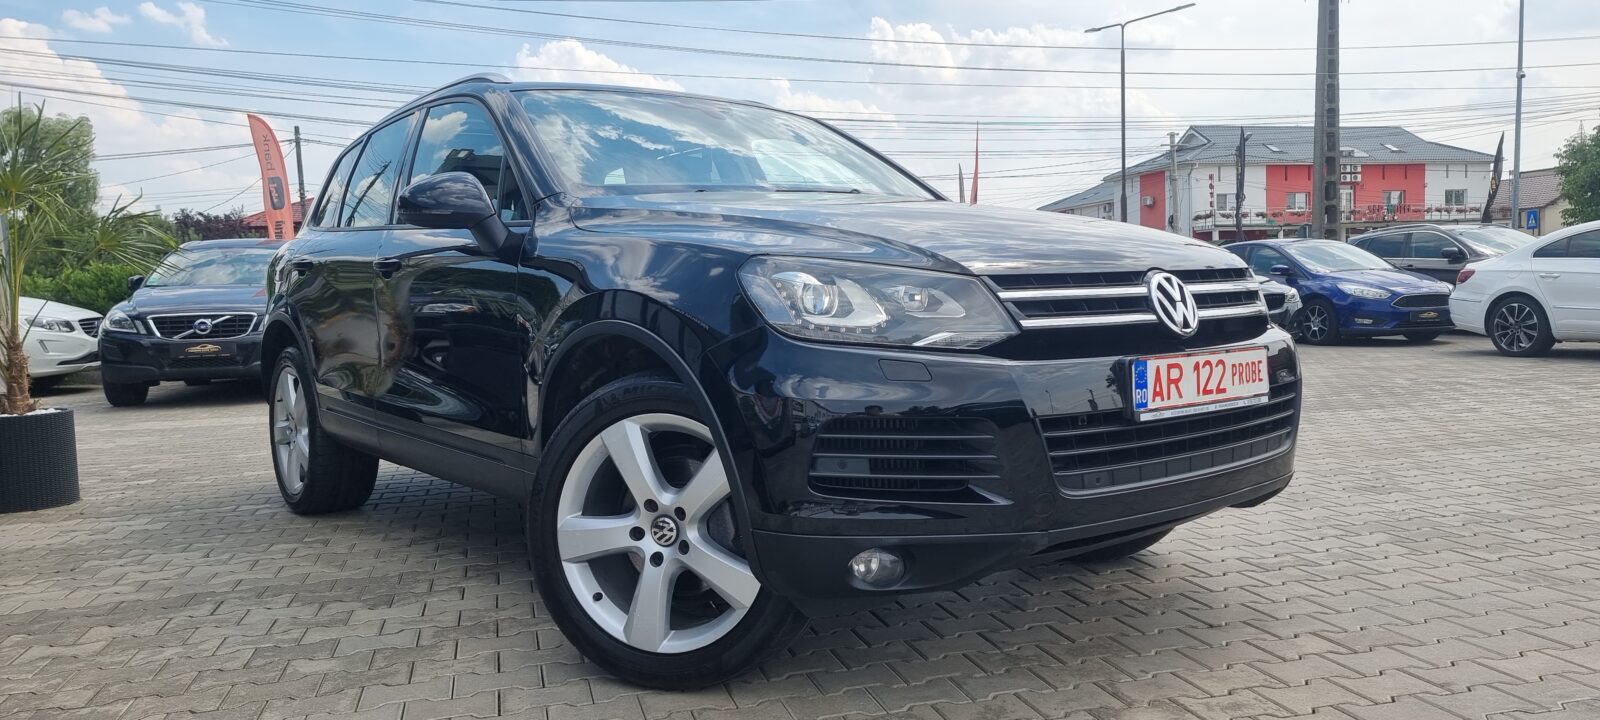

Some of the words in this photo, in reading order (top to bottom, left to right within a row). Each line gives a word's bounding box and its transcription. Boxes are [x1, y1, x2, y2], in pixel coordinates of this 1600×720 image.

[1136, 389, 1148, 405] RO
[1151, 363, 1183, 403] AR
[1193, 359, 1227, 397] 122
[1231, 360, 1263, 387] PROBE
